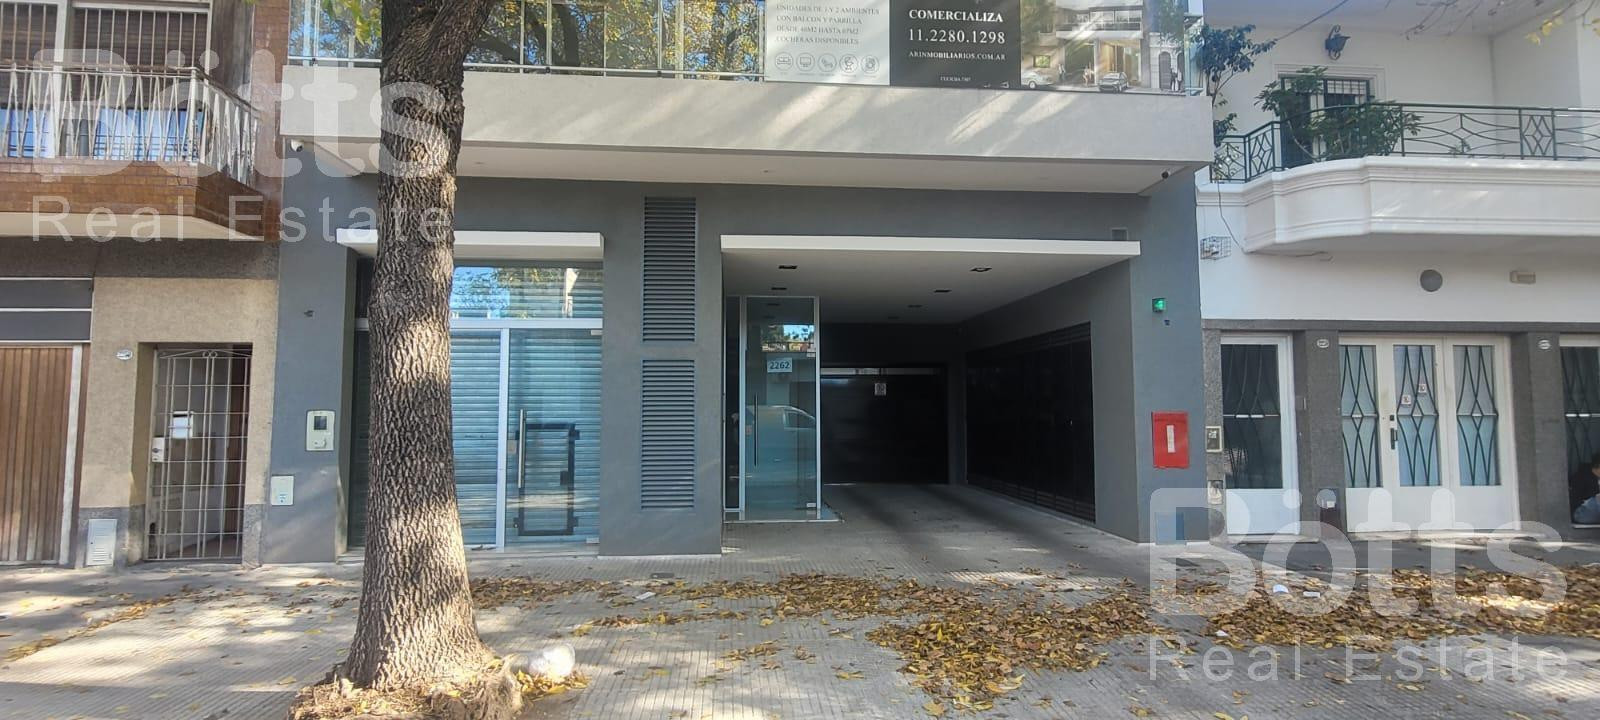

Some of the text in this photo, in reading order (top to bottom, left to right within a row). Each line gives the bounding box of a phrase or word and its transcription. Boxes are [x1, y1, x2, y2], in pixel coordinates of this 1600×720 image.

[908, 9, 1003, 22] COMERCIALIZA
[908, 28, 1005, 44] 11.2280.1298
[770, 361, 790, 370] 2262
